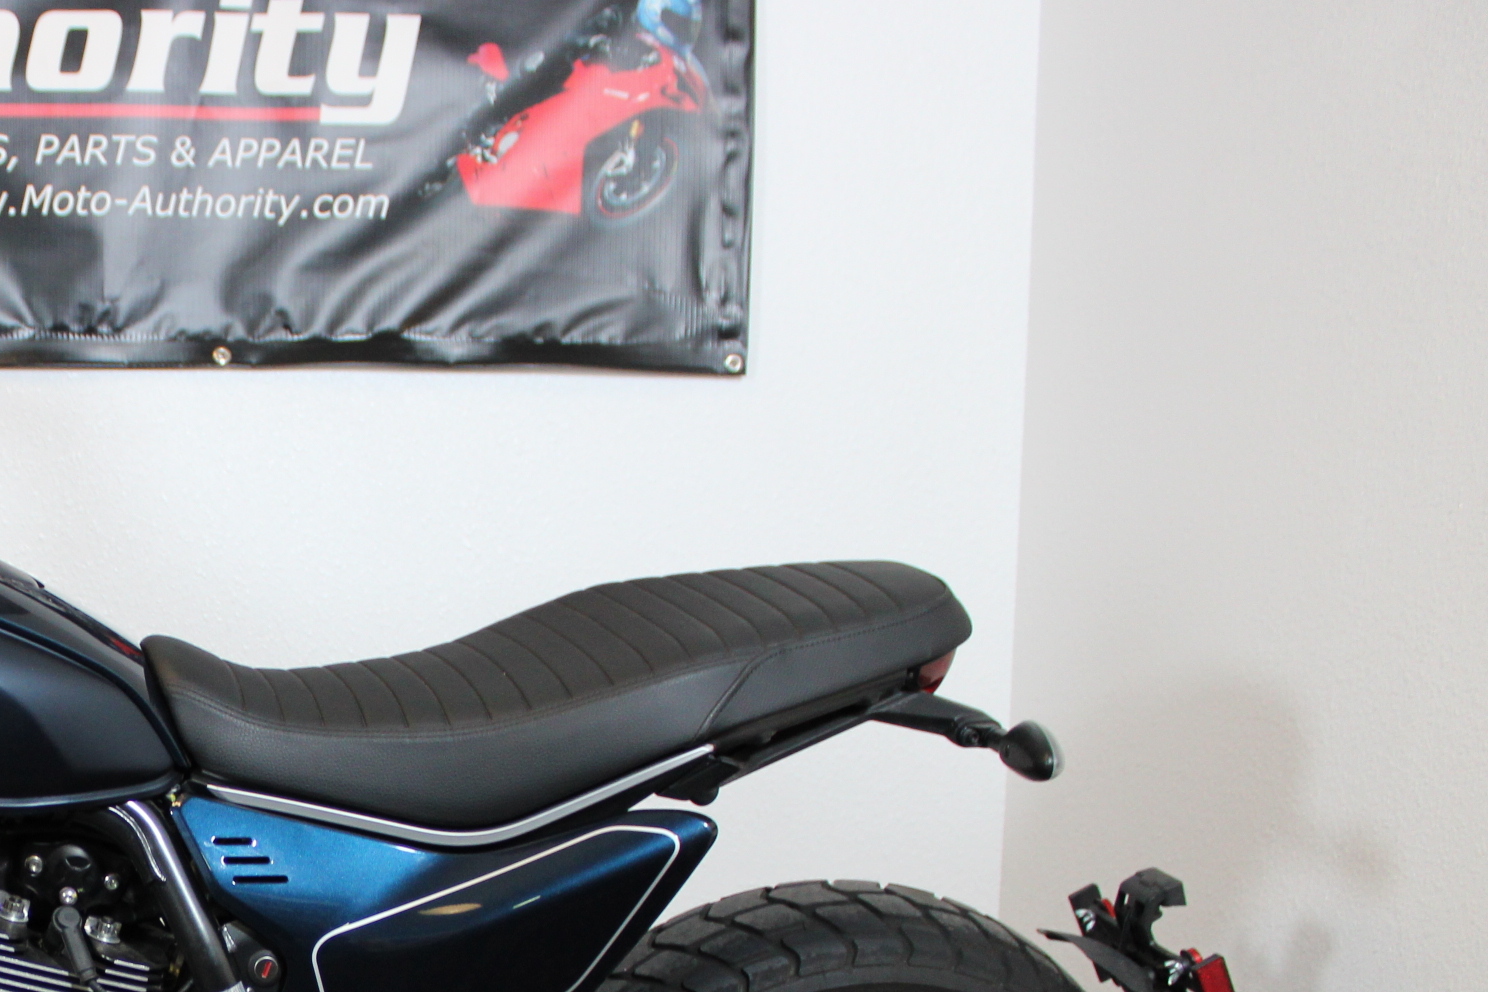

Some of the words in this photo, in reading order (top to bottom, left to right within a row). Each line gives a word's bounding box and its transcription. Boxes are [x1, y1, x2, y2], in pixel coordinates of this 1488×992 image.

[35, 134, 159, 167] PARTS
[170, 136, 197, 168] &
[207, 137, 374, 169] APPAREL
